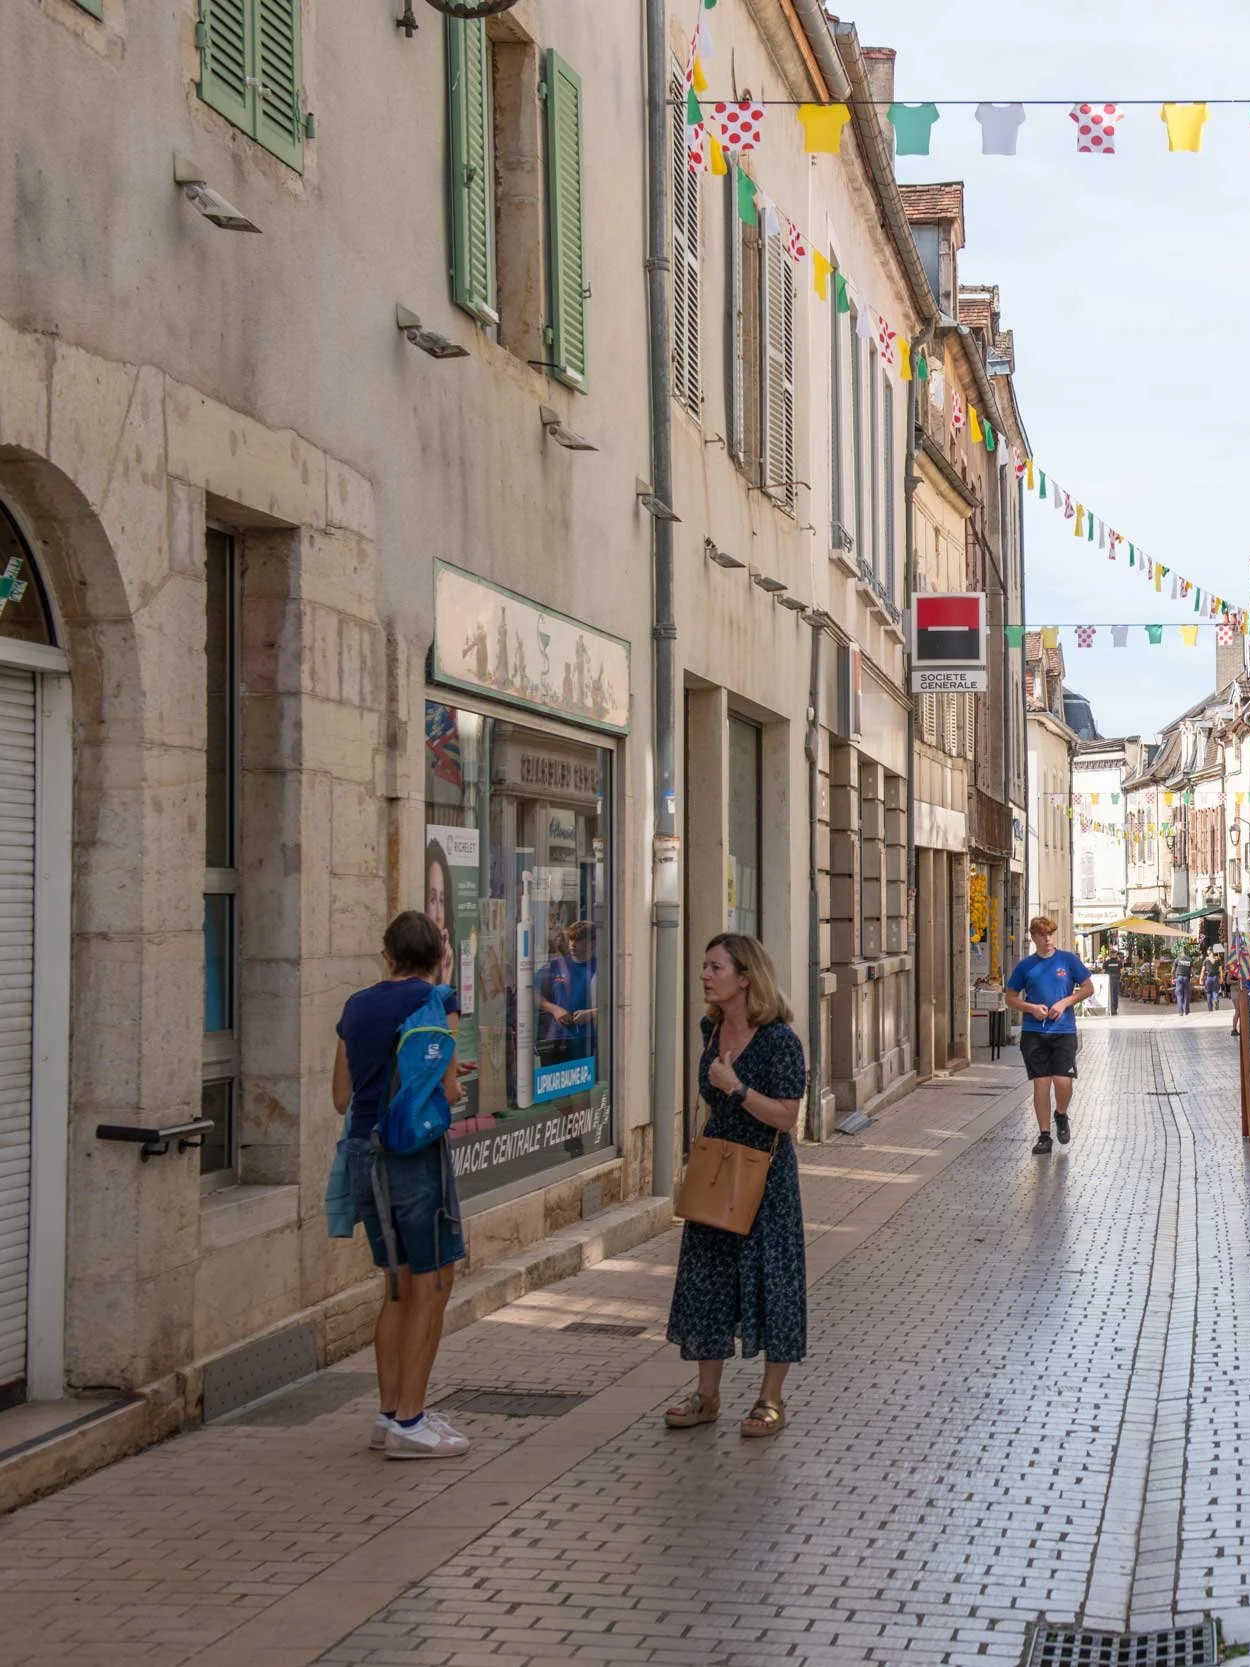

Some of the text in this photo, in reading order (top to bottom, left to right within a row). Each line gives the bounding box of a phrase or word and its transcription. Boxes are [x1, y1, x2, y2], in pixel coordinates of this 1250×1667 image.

[920, 673, 967, 682] SOCIETE
[920, 681, 978, 690] GENERALE
[451, 1139, 492, 1178] MACIE
[492, 1122, 543, 1166] CENTRALE
[543, 1107, 594, 1148] PELLEGRIN
